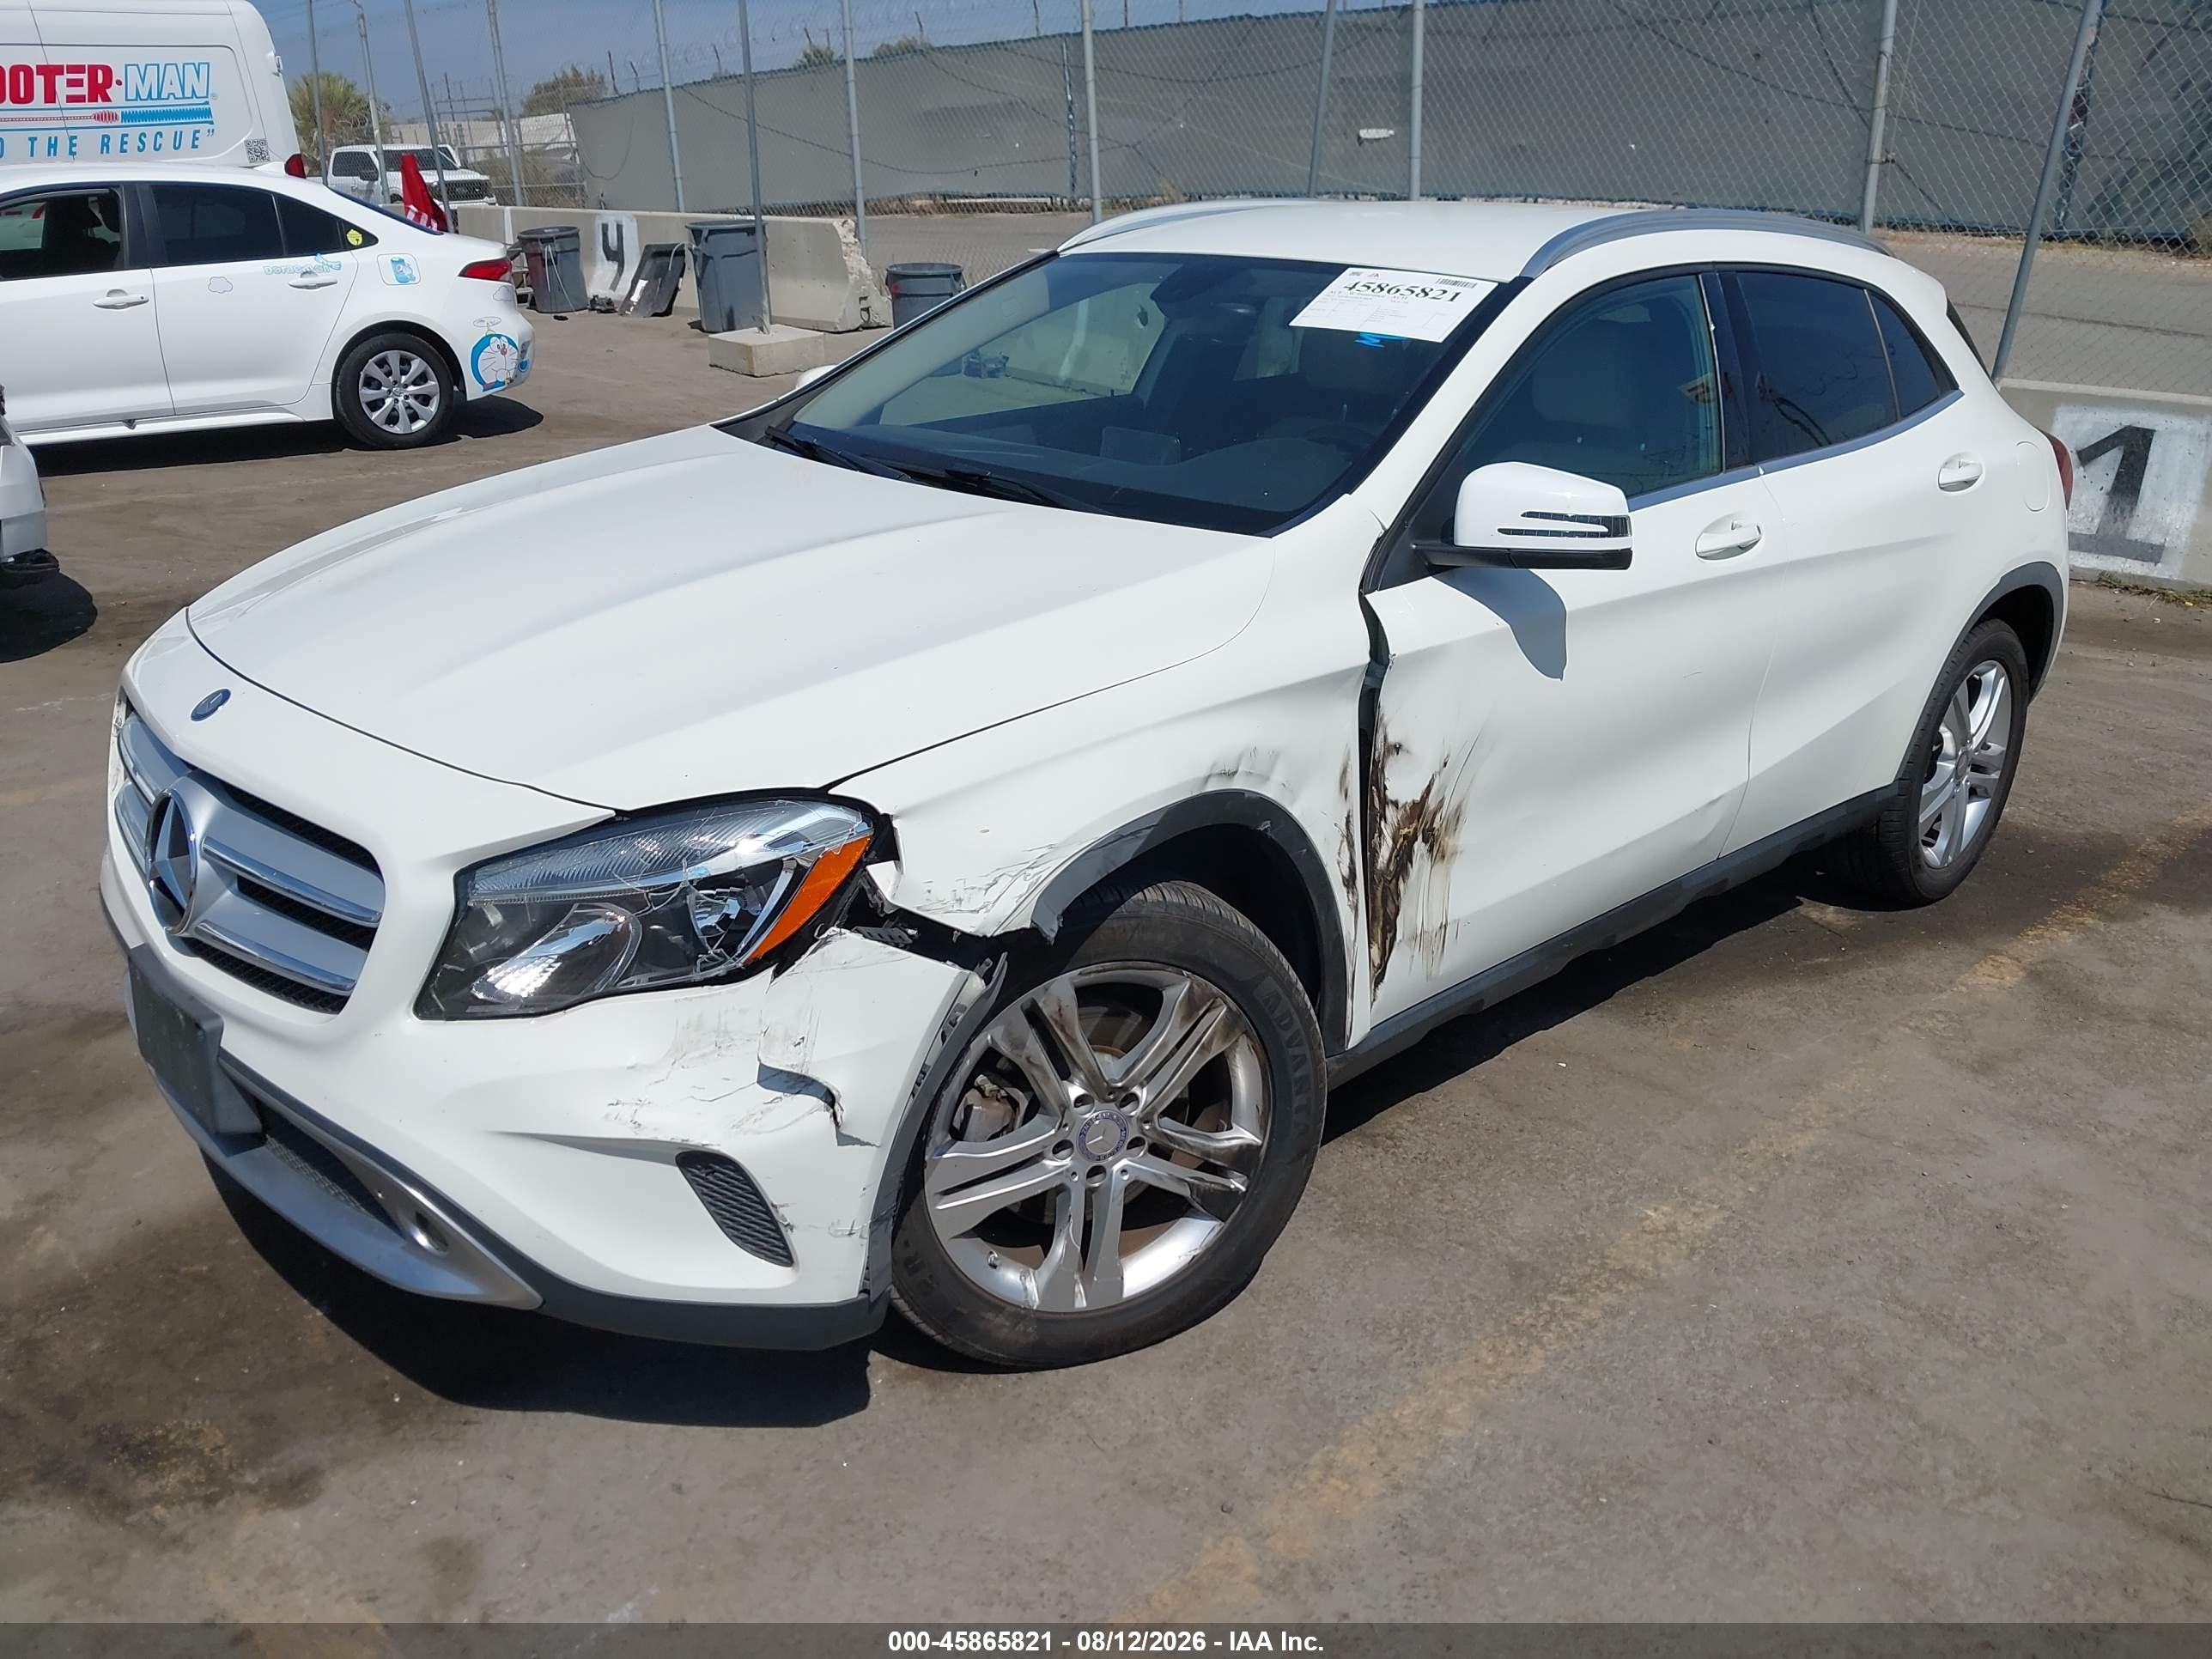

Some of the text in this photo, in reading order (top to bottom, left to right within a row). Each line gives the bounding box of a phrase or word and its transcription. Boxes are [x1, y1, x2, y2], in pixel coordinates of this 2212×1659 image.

[27, 135, 77, 157] THE
[1343, 280, 1462, 301] 45865821
[2069, 425, 2166, 565] 1
